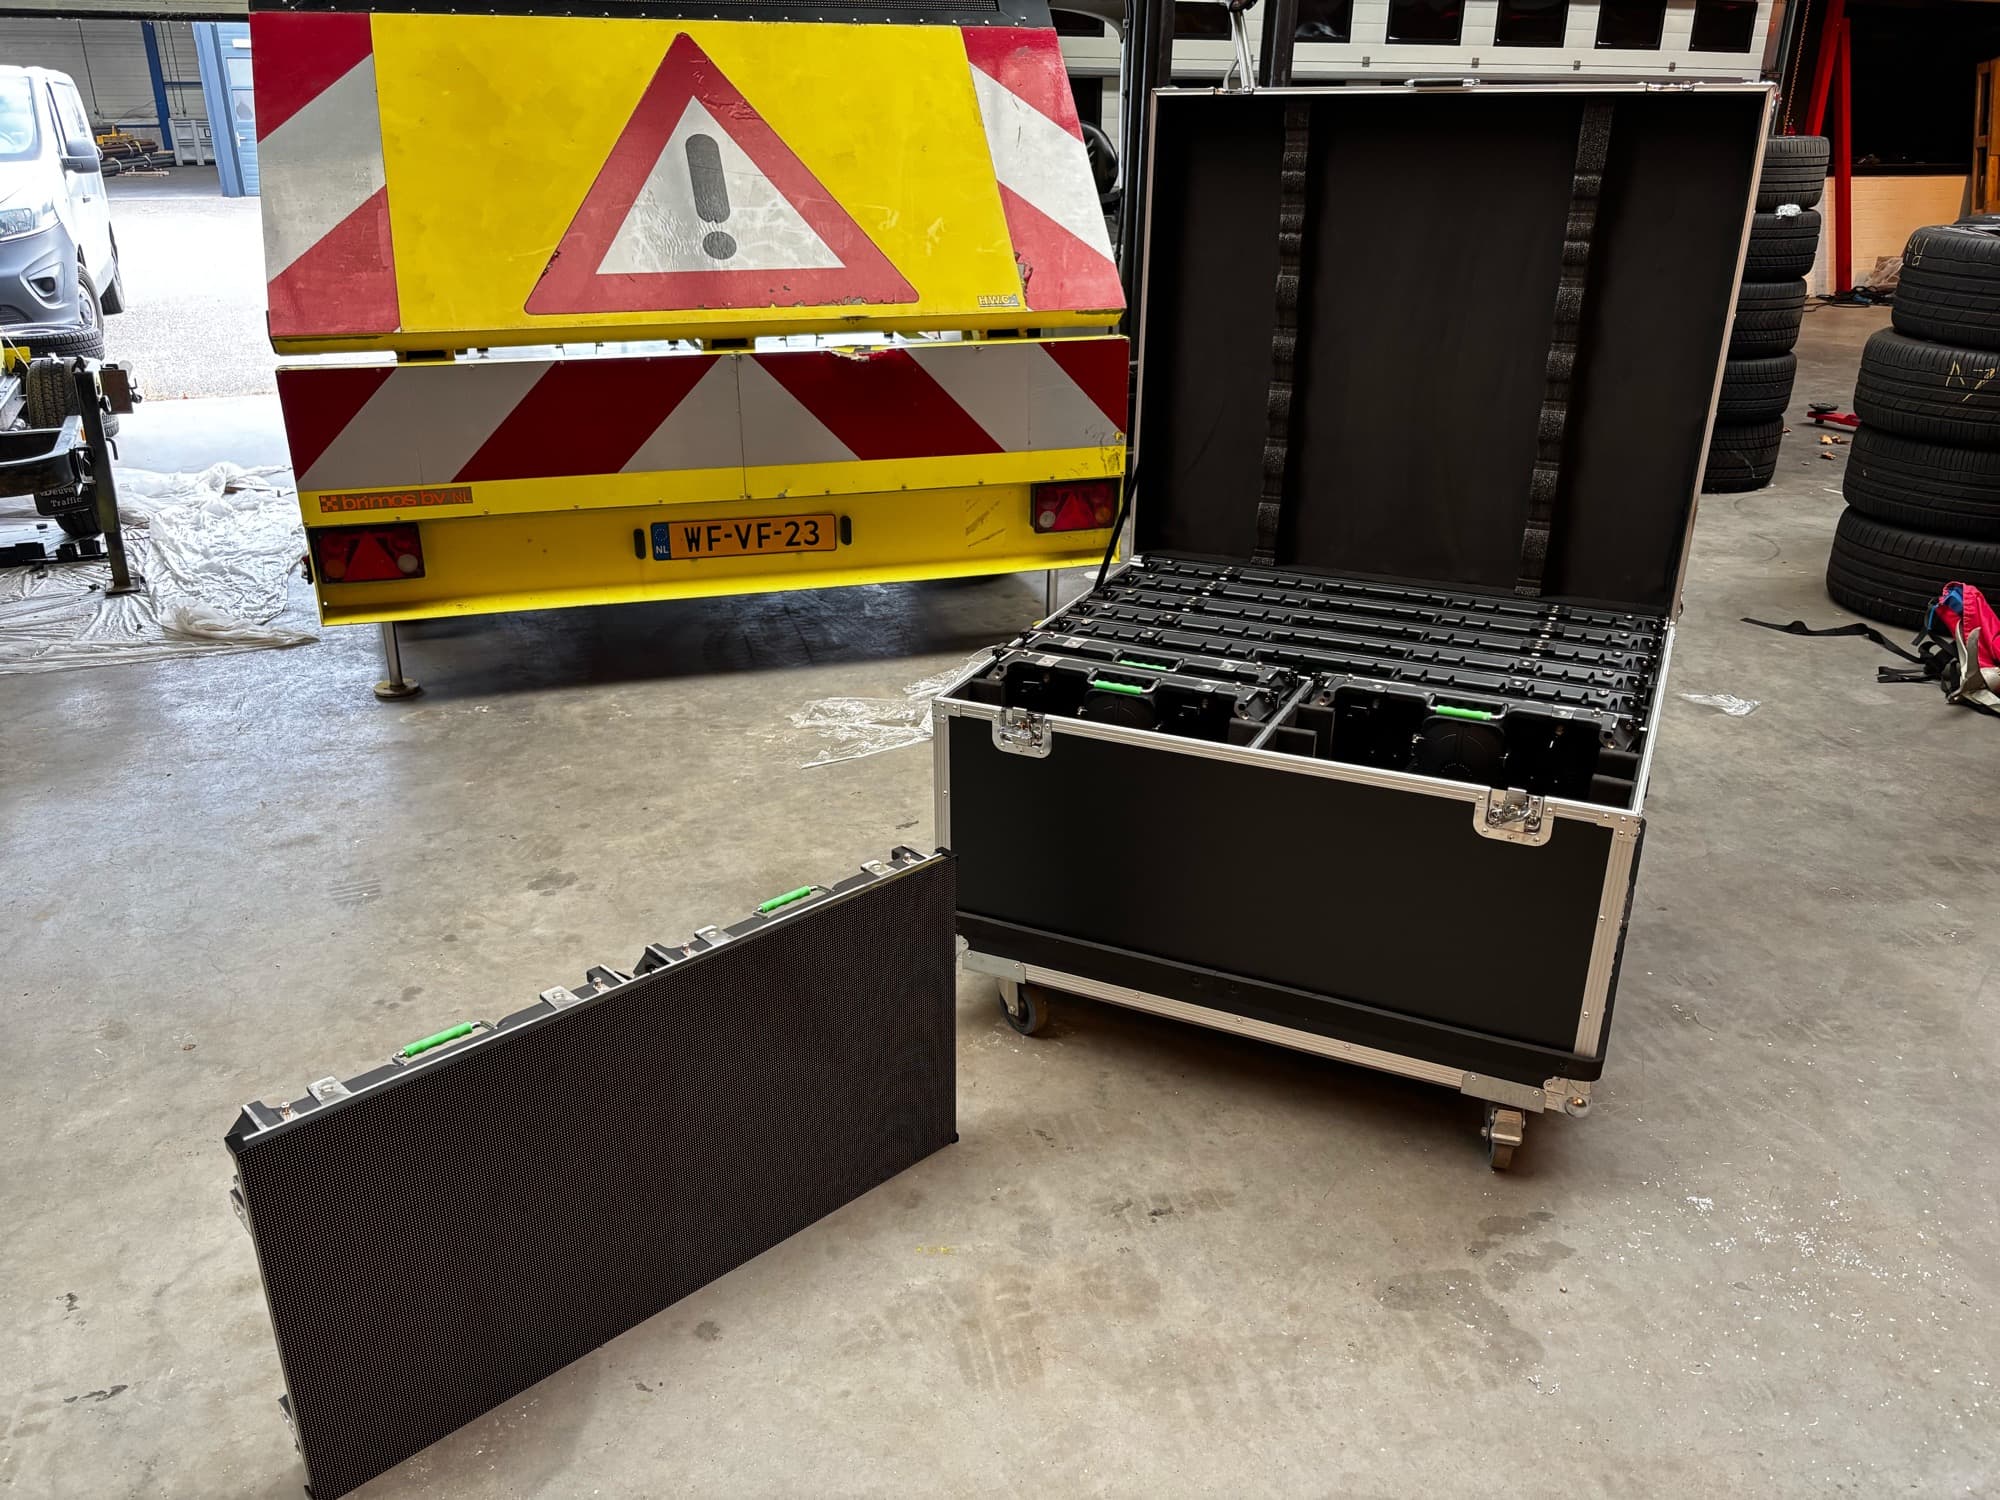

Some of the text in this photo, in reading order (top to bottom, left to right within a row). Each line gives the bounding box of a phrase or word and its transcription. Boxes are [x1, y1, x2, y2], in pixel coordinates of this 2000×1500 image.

[50, 496, 83, 508] Traffic
[342, 488, 473, 512] brimos bv NL
[684, 520, 820, 553] WF-VF-23
[655, 545, 669, 554] NL
